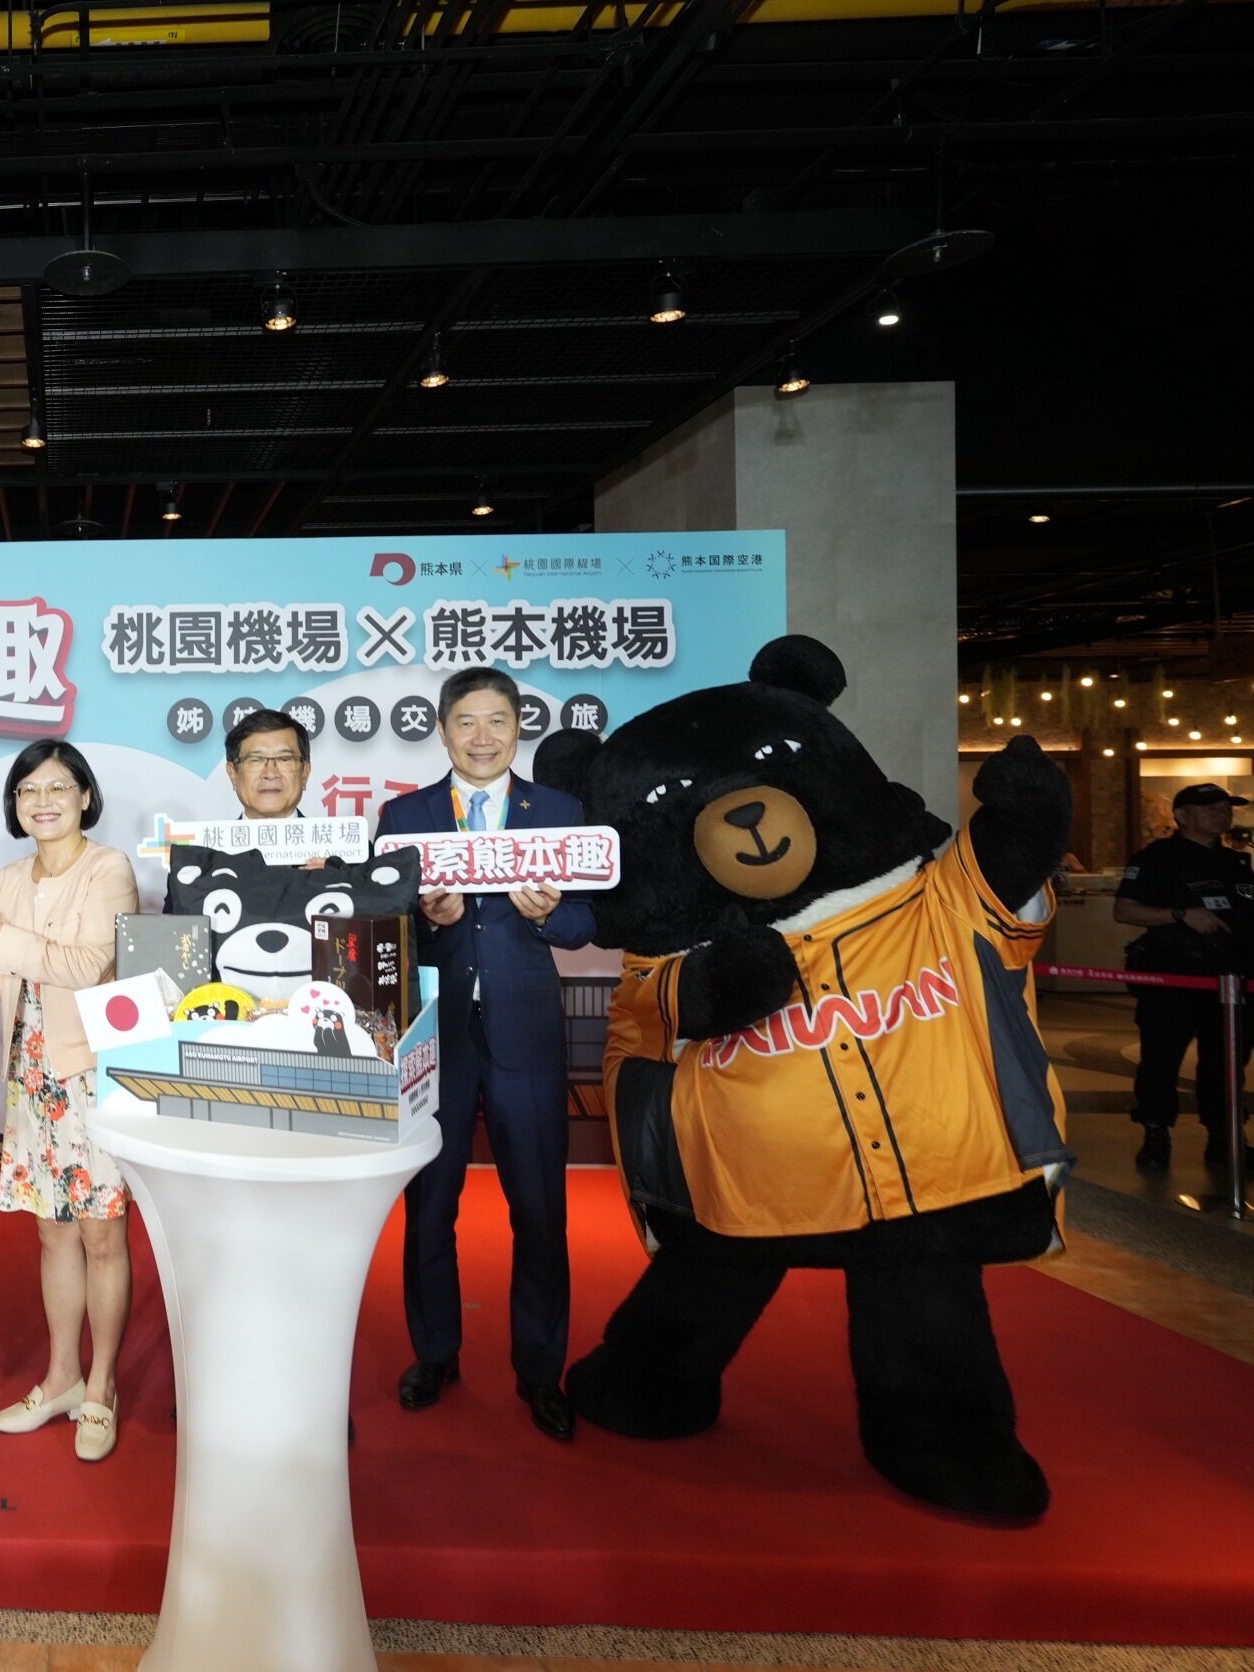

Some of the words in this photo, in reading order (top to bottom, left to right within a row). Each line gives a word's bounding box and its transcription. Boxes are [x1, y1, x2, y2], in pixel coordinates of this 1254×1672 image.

[523, 557, 603, 570] 桃園國際機場
[681, 553, 763, 567] 熊本国際空港
[419, 561, 464, 577] 熊本県
[108, 608, 343, 668] 桃園機場
[431, 605, 669, 663] 熊本機場
[202, 822, 361, 848] 桃園國際機場
[264, 849, 320, 860] ernational
[324, 848, 363, 858] Airport
[702, 956, 960, 1068] AIWAN
[232, 1055, 258, 1064] AIRPORT
